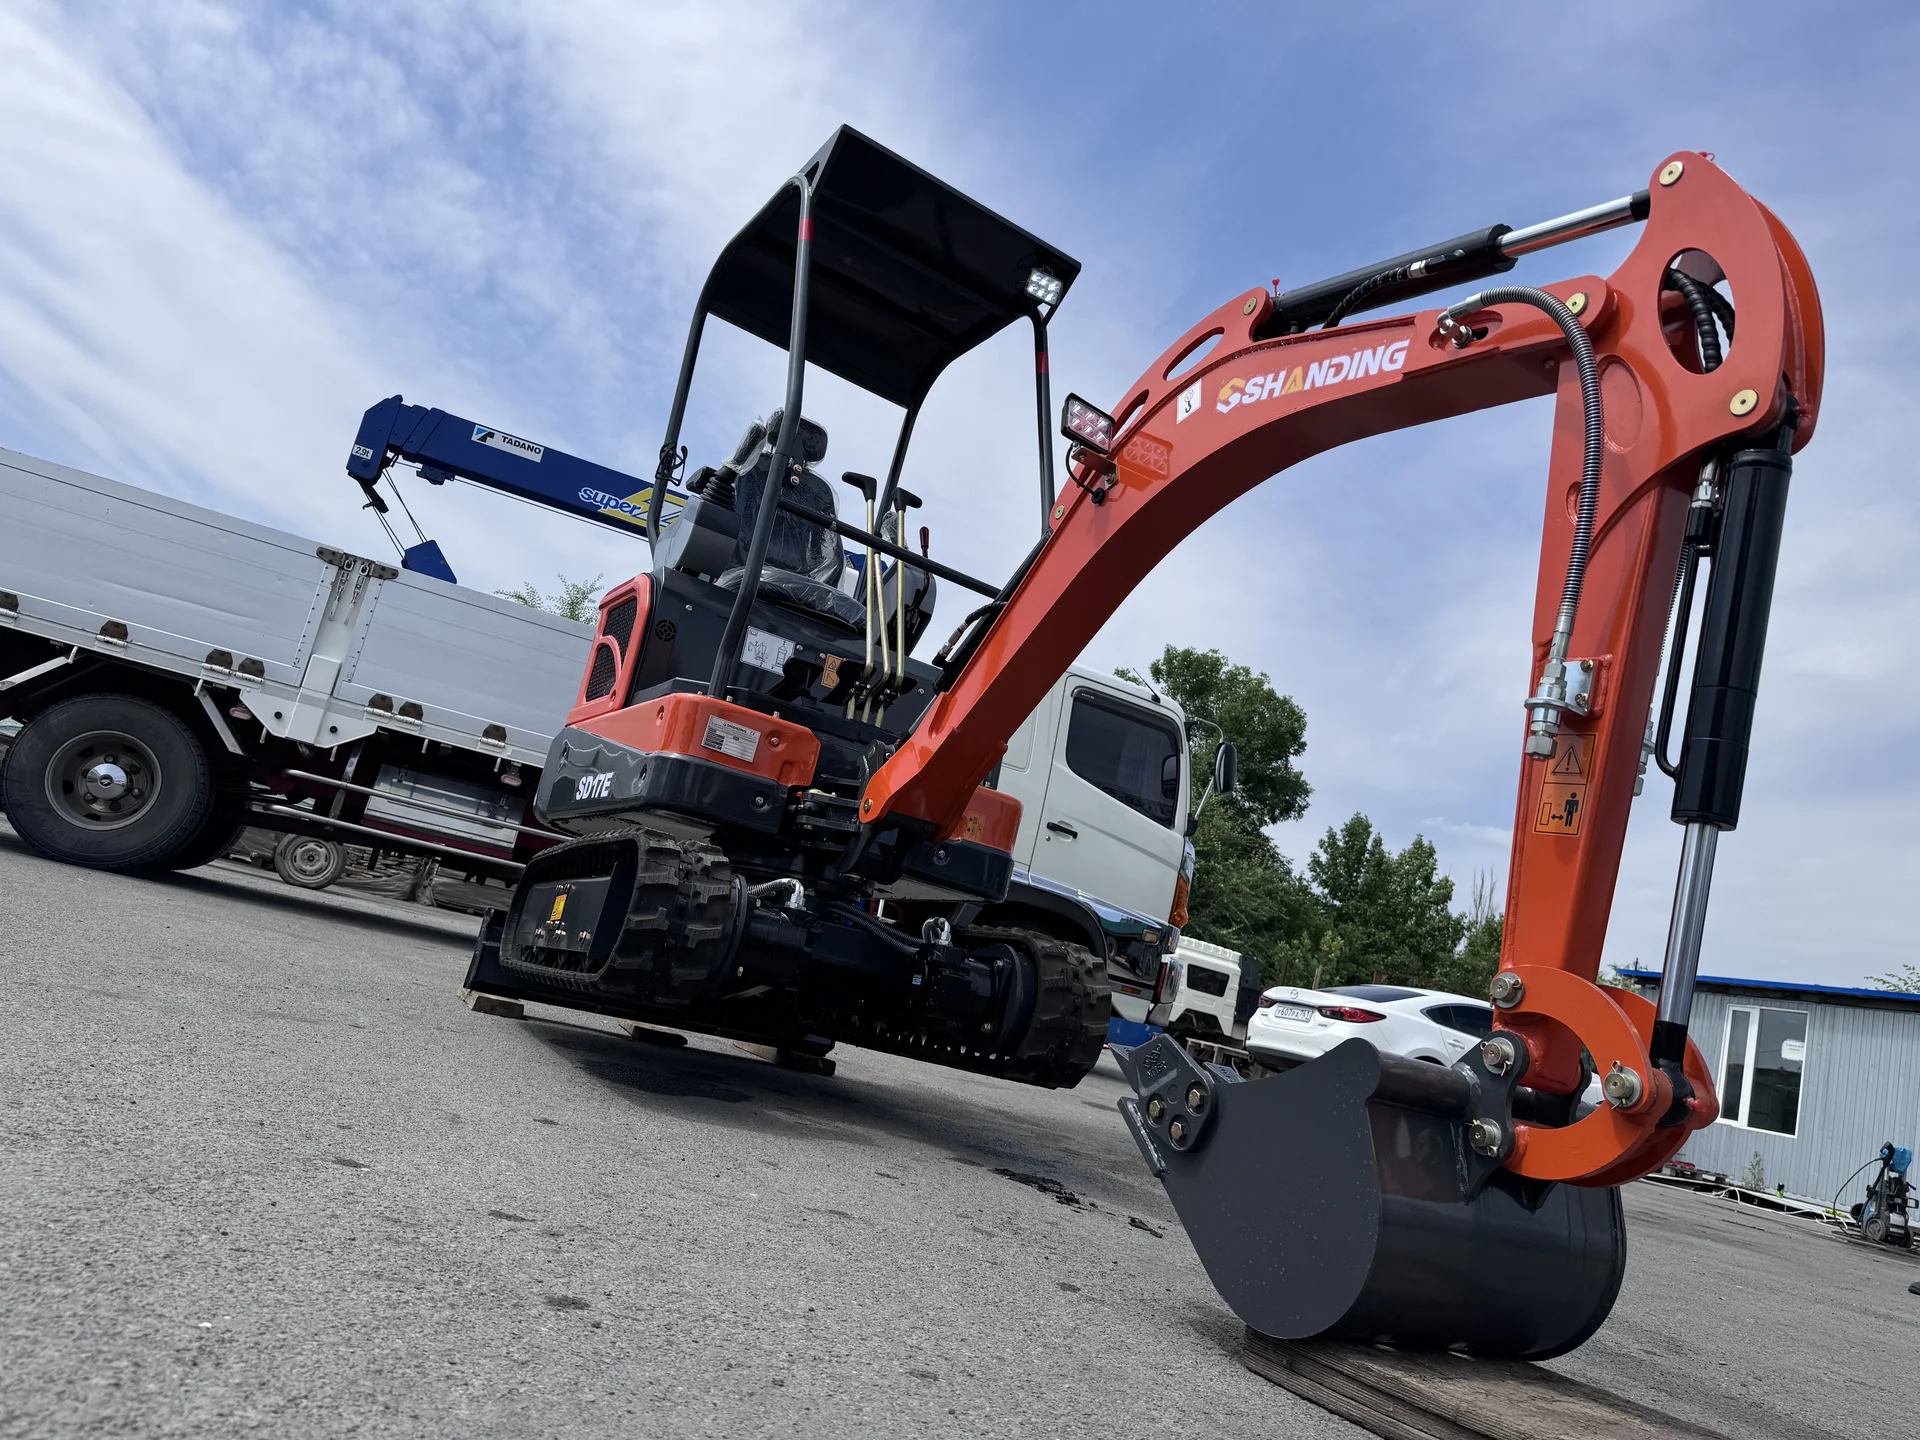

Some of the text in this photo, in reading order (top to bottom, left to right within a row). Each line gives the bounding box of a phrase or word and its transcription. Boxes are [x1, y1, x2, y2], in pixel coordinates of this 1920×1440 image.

[1241, 339, 1410, 404] SHANDING
[502, 435, 542, 454] TADANO
[576, 772, 614, 800] SD17E
